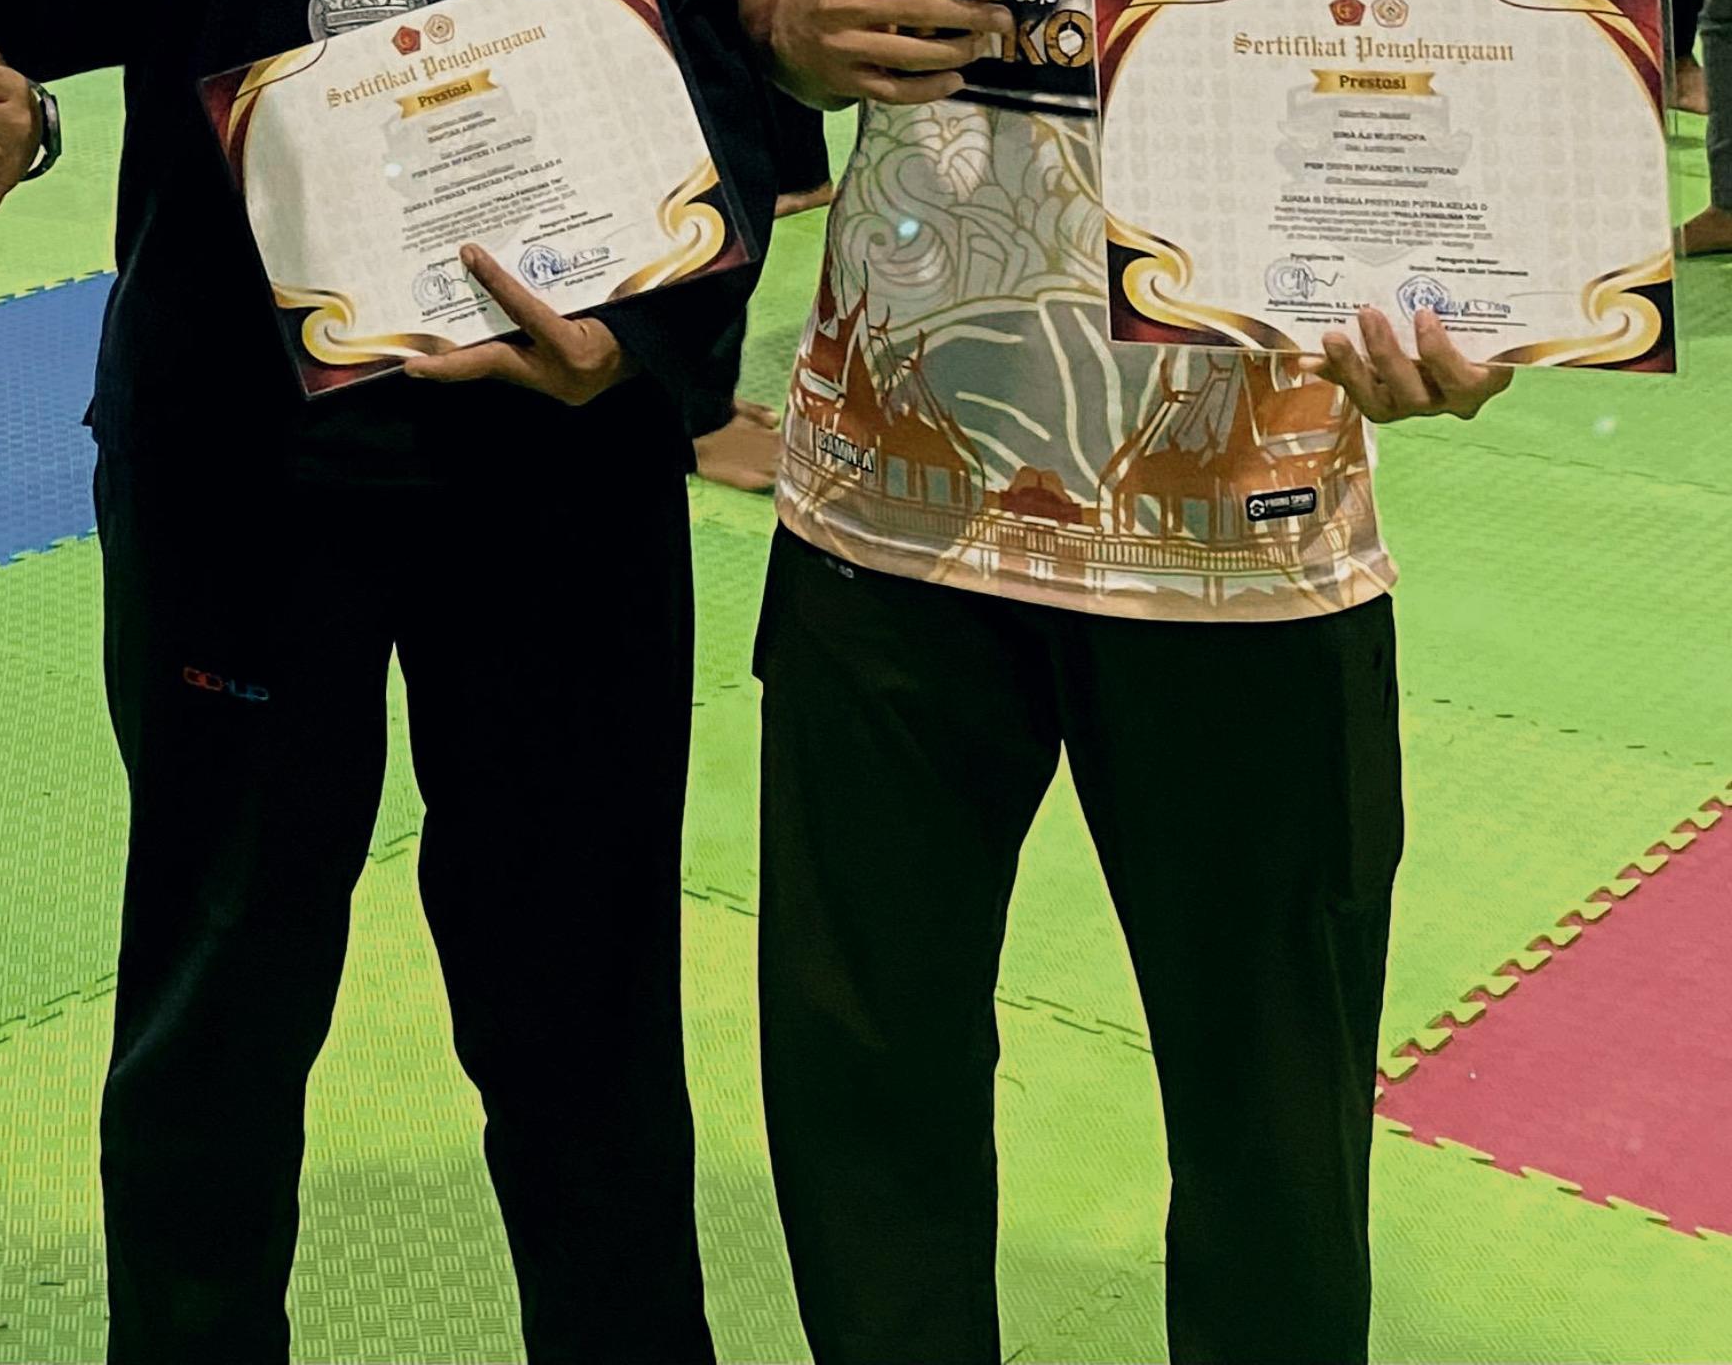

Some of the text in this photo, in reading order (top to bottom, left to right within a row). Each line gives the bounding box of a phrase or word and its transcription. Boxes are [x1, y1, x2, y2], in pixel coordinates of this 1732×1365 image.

[1233, 33, 1514, 65] Sertifikat Penghargaan
[326, 25, 546, 109] Sertifikat Penghargaan
[417, 81, 473, 108] Prestasi
[1339, 75, 1407, 90] Prestasi
